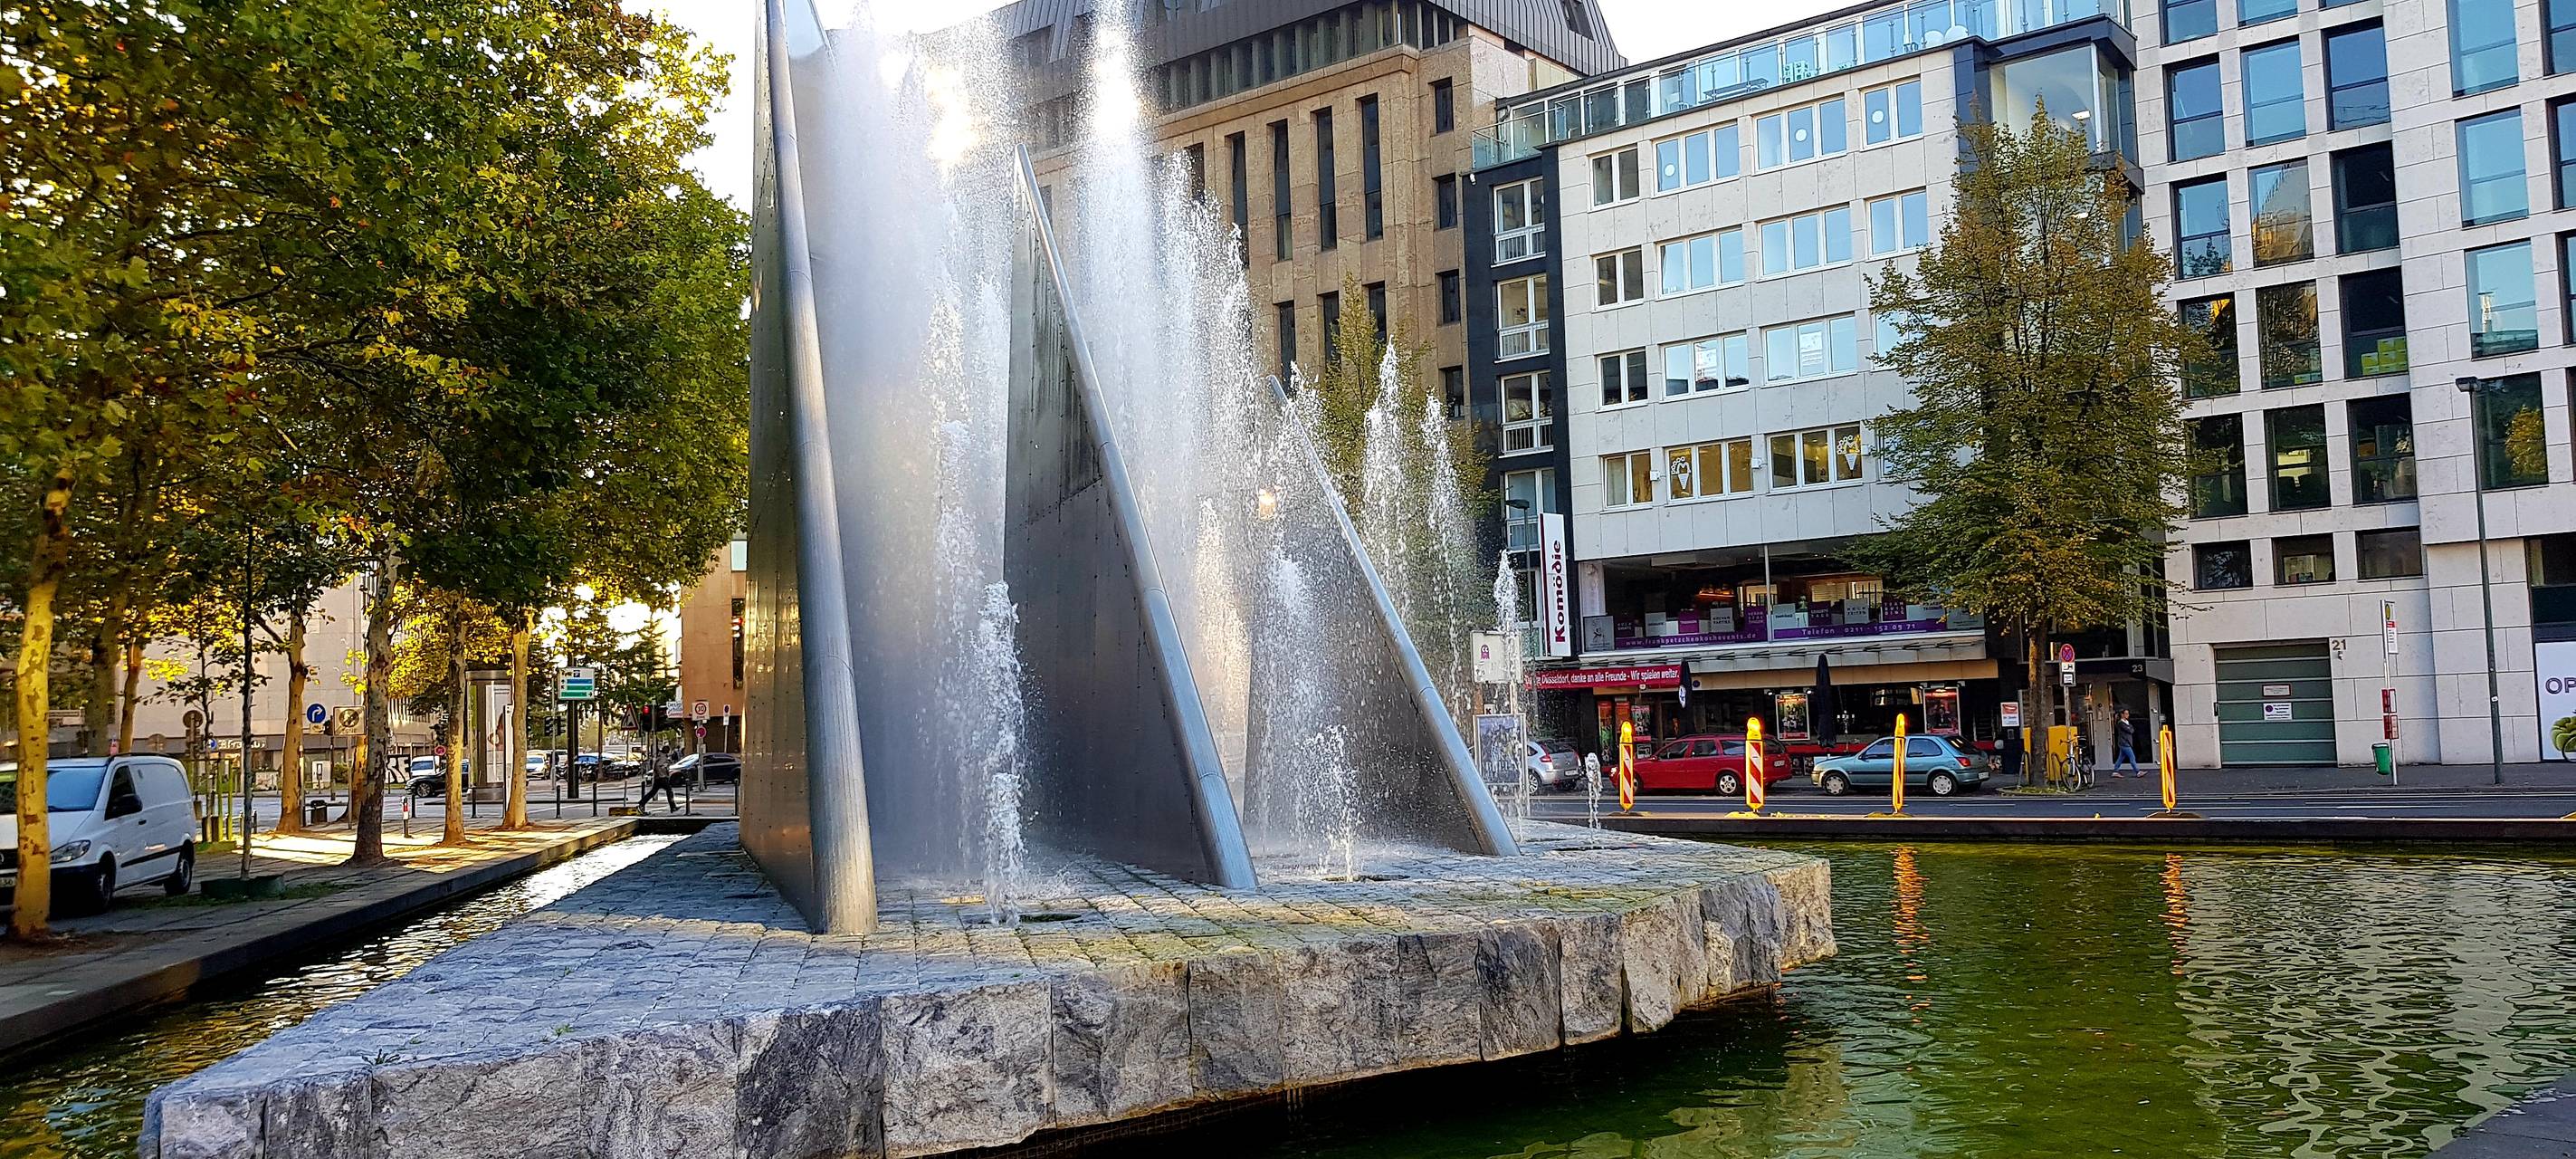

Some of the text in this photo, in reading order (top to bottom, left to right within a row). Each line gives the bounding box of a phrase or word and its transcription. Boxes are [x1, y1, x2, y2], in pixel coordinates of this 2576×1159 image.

[1551, 540, 1566, 643] Komödie
[1801, 627, 1835, 636] Telefon
[2332, 639, 2347, 650] 21
[2132, 665, 2143, 673] 23
[1571, 674, 1587, 684] danke
[1587, 675, 1594, 683] an
[1595, 673, 1605, 682] alle
[1605, 671, 1627, 682] Freunde
[1630, 669, 1640, 679] Wir
[1641, 669, 1660, 682] spielen
